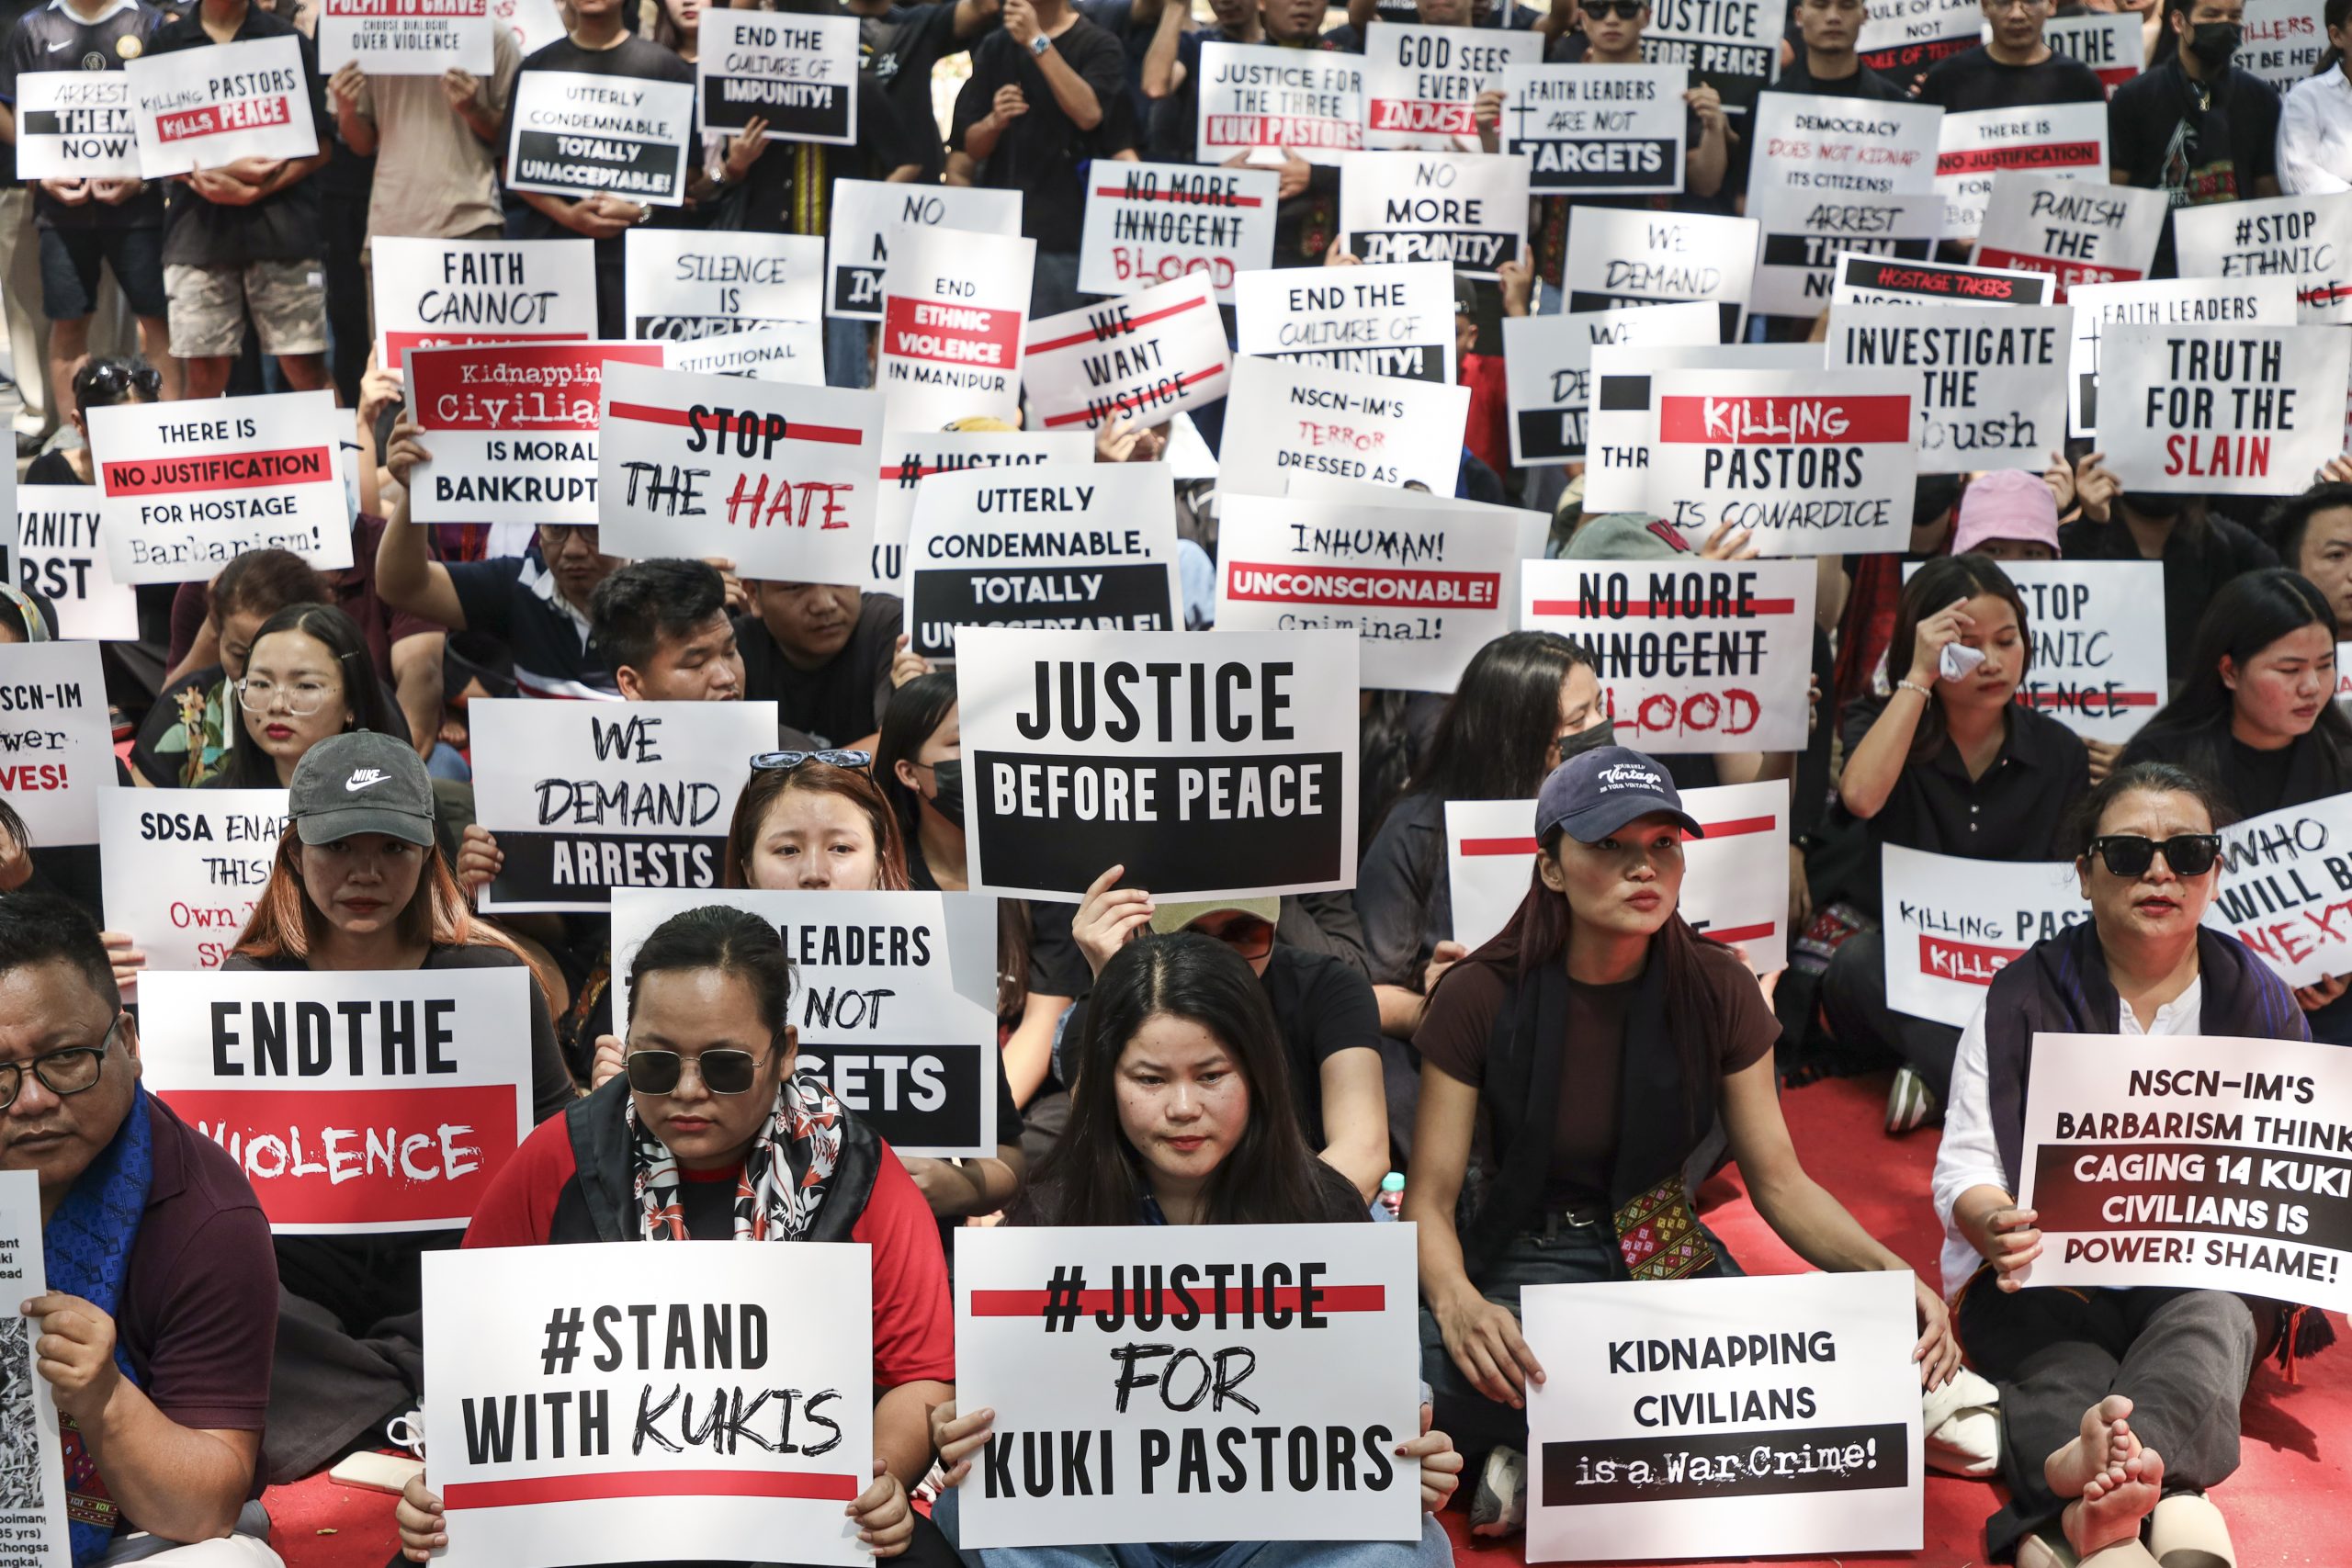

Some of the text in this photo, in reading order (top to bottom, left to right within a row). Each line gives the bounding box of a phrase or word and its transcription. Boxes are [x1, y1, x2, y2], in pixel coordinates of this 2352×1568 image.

[353, 33, 460, 50] OVER VIOLENCE
[735, 26, 822, 50] END THE
[1906, 21, 1941, 38] NOT
[726, 53, 832, 79] CULTURE OF
[1399, 34, 1449, 68] GOD
[1702, 45, 1767, 76] PEACE
[2261, 50, 2283, 68] BE
[141, 68, 296, 112] KILLING PASTORS
[724, 78, 832, 108] IMPUNITY!
[1216, 63, 1362, 93] JUSTICE FOR
[1419, 74, 1486, 100] EVERY
[1530, 82, 1656, 101] FAITH LEADERS
[566, 87, 644, 107] UTTERLY
[1234, 89, 1341, 118] THE THREE
[55, 109, 134, 134] THEM
[162, 97, 284, 139] KILLS PEACE
[530, 110, 672, 140] CONDEMNABLE,
[1210, 117, 1363, 149] KUKI PASTORS
[1547, 111, 1637, 132] ARE NOT
[1796, 115, 1901, 137] DEMOCRACY
[1979, 120, 2050, 140] THERE IS
[558, 137, 641, 163] TOTALLY
[1520, 141, 1662, 172] TARGETS
[1939, 144, 2093, 170] NO JUSTIFICATION
[521, 160, 671, 193] UNACCEPTABLE!
[1125, 171, 1239, 208] NO MORE
[1416, 162, 1456, 188] NO
[1815, 173, 1893, 194] CITIZENS!
[903, 195, 944, 226] NO
[1386, 199, 1483, 224] MORE
[1805, 204, 1905, 231] ARREST
[2030, 191, 2127, 230] PUNISH
[1114, 209, 1243, 248] INNOCENT
[1649, 221, 1689, 252] WE
[2044, 227, 2098, 259] THE
[2235, 210, 2317, 247] #STOP
[1363, 233, 1504, 266] IMPUNITY
[2222, 243, 2336, 278] ETHNIC
[444, 253, 524, 284] FAITH
[676, 254, 786, 285] SILENCE
[1113, 247, 1235, 289] BLOOD
[1606, 260, 1721, 295] DEMAND
[1878, 268, 1950, 292] HOSTAGE
[1956, 275, 2012, 299] TAKERS
[720, 288, 741, 313] IS
[936, 277, 976, 298] END
[1290, 284, 1406, 311] END THE
[418, 290, 559, 324] CANNOT
[914, 304, 990, 333] ETHNIC
[2104, 297, 2257, 325] FAITH LEADERS
[1089, 305, 1136, 343] WE
[1280, 316, 1420, 345] CULTURE OF
[898, 333, 1002, 365] VIOLENCE
[1847, 327, 2055, 365] INVESTIGATE
[2167, 338, 2282, 383] TRUTH
[888, 362, 1005, 393] IN MANIPUR
[1083, 339, 1161, 387] WANT
[1087, 371, 1190, 429] JUSTICE
[1291, 387, 1404, 418] NSCN-IM'S
[1923, 370, 1978, 407] THE
[1703, 396, 1849, 443] KILLING
[2146, 387, 2213, 428] FOR
[2233, 388, 2297, 430] THE
[158, 419, 256, 444] THERE IS
[687, 403, 786, 460] STOP
[1299, 422, 1385, 450] TERROR
[487, 441, 506, 460] IS
[1278, 450, 1397, 483] DRESSED AS
[2165, 434, 2271, 478] SLAIN
[113, 454, 320, 487] NO JUSTIFICATION
[1704, 447, 1863, 490] PASTORS
[436, 476, 598, 502] BANKRUPT
[620, 461, 854, 530] THE HATE
[978, 486, 1094, 513] UTTERLY
[141, 496, 298, 525] FOR HOSTAGE
[1672, 499, 1892, 530] IS COWARDICE
[929, 530, 1150, 558] CONDEMNABLE,
[1291, 525, 1444, 567] INHUMAN!
[971, 575, 1102, 604] TOTALLY
[1234, 570, 1493, 603] UNCONSCIONABLE!
[1579, 572, 1757, 620] NO MORE
[1016, 660, 1295, 743] JUSTICE
[592, 715, 662, 763] WE
[353, 769, 381, 781] NIKE
[535, 778, 720, 828] DEMAND
[992, 761, 1323, 822] BEFORE PEACE
[141, 812, 213, 841] SDSA
[2221, 818, 2329, 874] WHO
[553, 840, 714, 888] ARRESTS
[2217, 869, 2323, 925] WILL
[170, 901, 238, 929] Own
[1899, 900, 2003, 940] KILLING
[781, 925, 931, 967] LEADERS
[1930, 944, 2009, 979] KILLS
[804, 987, 897, 1030] NOT
[2129, 1069, 2315, 1105] NSCN-IM'S
[2056, 1112, 2243, 1141] BARBARISM
[198, 1119, 484, 1185] VIOLENCE
[2074, 1153, 2352, 1199] CAGING 14 KUKI
[2102, 1194, 2310, 1235] CIVILIANS IS
[2064, 1237, 2338, 1284] POWER! SHAME!
[1043, 1262, 1329, 1333] #JUSTICE
[541, 1303, 769, 1375] #STAND
[1609, 1331, 1836, 1374] KIDNAPPING
[1110, 1342, 1261, 1416] FOR
[1634, 1387, 1817, 1427] CIVILIANS
[461, 1383, 842, 1465] WITH KUKIS
[984, 1425, 1394, 1499] KUKI PASTORS
[1576, 1438, 1877, 1486] is a War Crime!
[16, 1528, 40, 1540] yrs)
